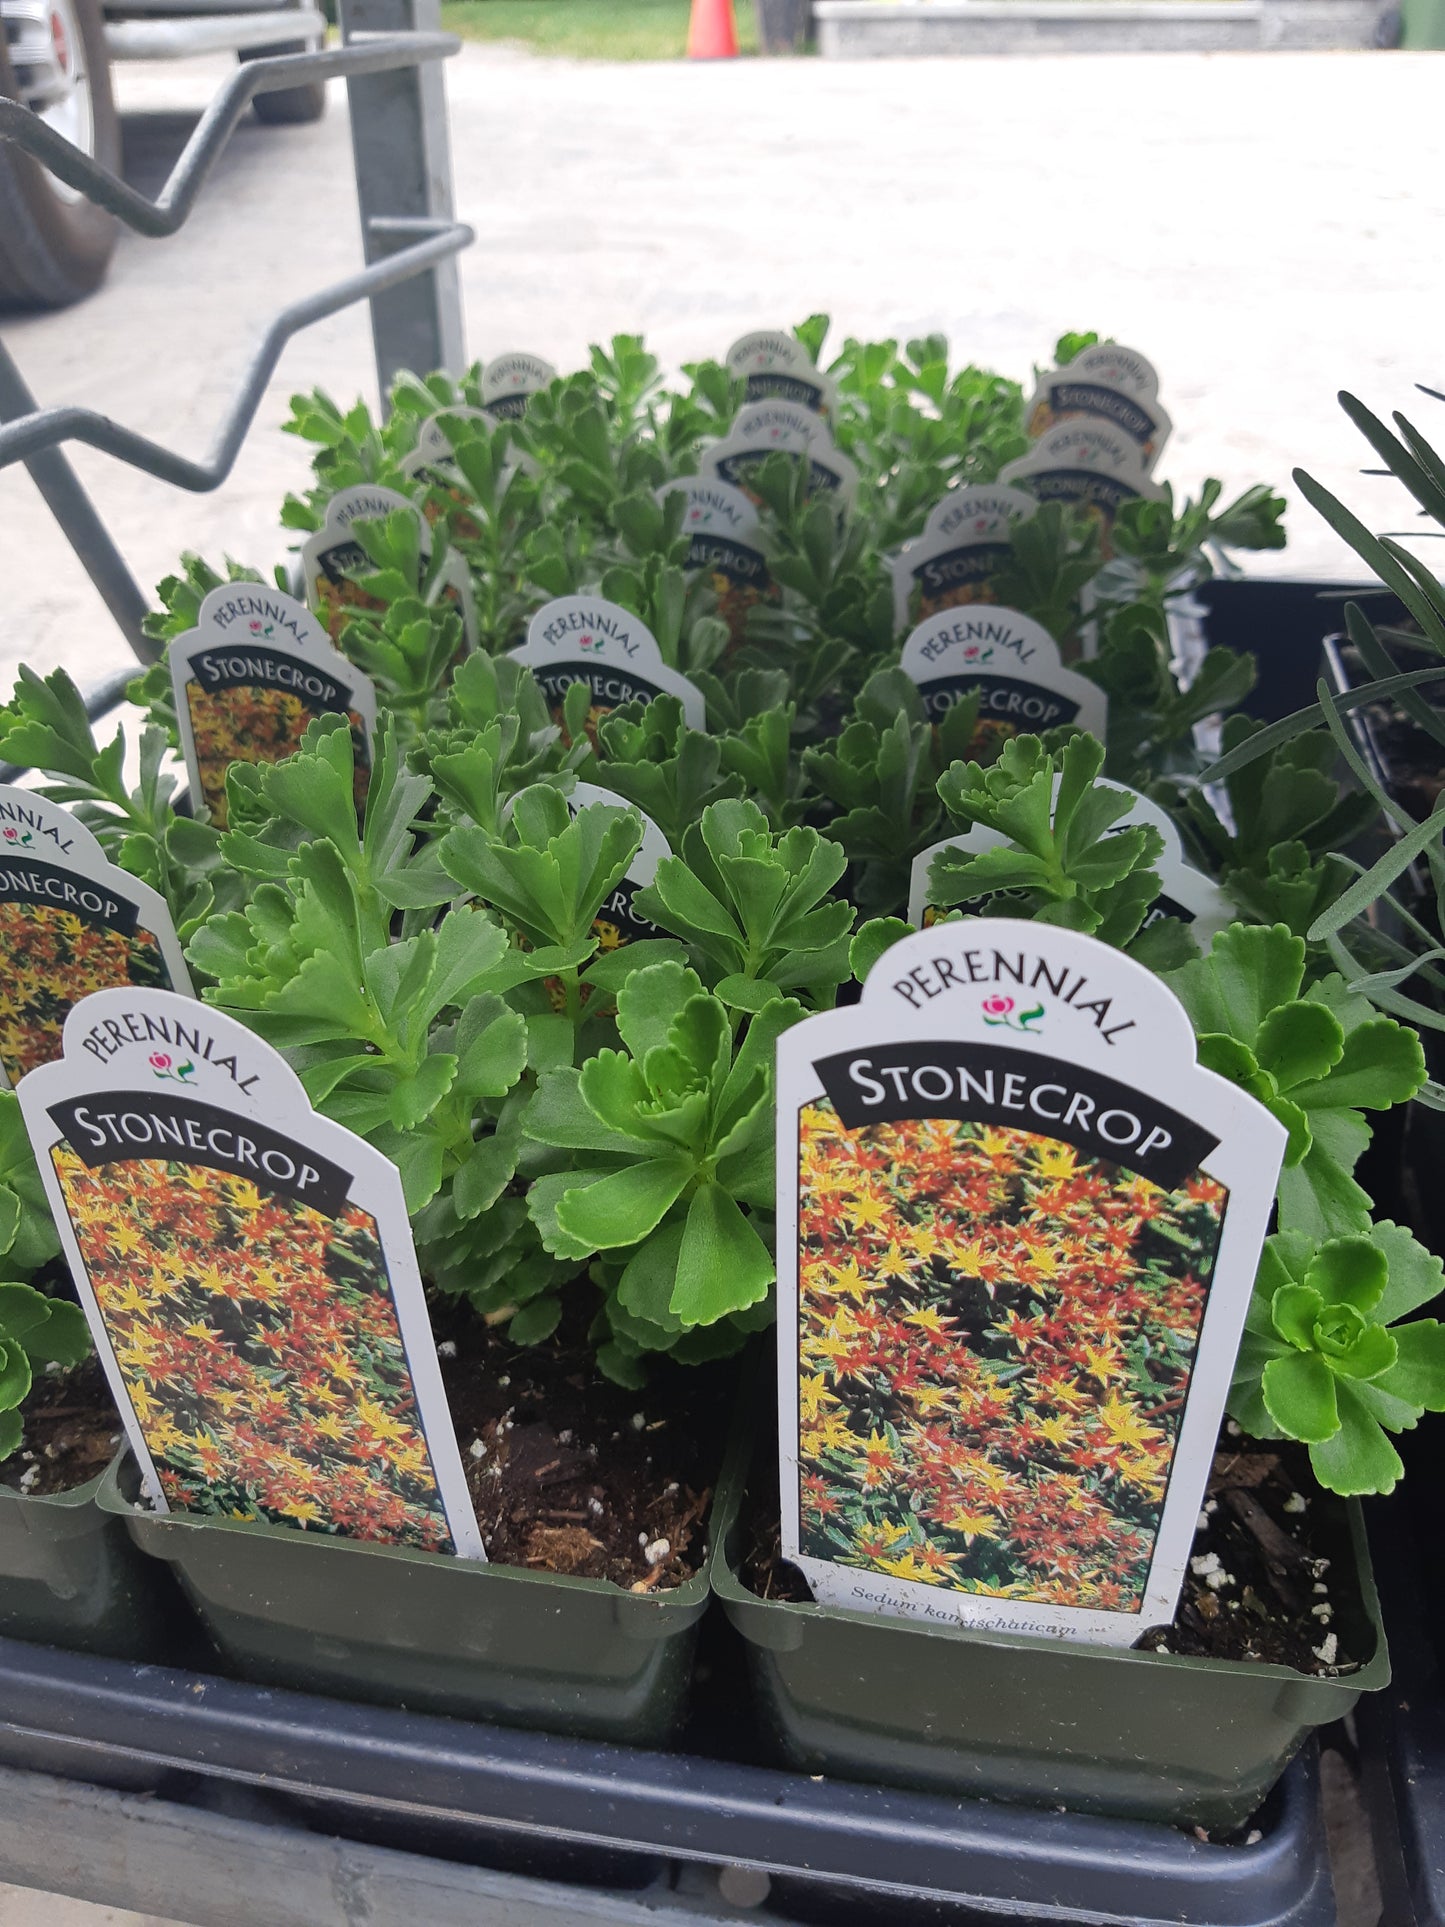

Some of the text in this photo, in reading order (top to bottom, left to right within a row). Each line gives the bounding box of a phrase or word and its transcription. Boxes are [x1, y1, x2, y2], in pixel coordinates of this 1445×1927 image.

[213, 597, 309, 646] PERENNIAL
[543, 611, 640, 658] PERENNIAL
[920, 621, 1037, 665] PERENNIAL
[203, 655, 337, 702] STONECROP
[532, 673, 652, 705] STOECRO
[922, 687, 1061, 722] TOECROP
[0, 802, 74, 855] NNIAL
[893, 949, 1138, 1046] PERENNIAL
[82, 1013, 261, 1097] PERENNIAL
[848, 1059, 1173, 1158] STONECROP
[74, 1107, 320, 1190] STONECROP
[850, 1585, 918, 1612] Sedum
